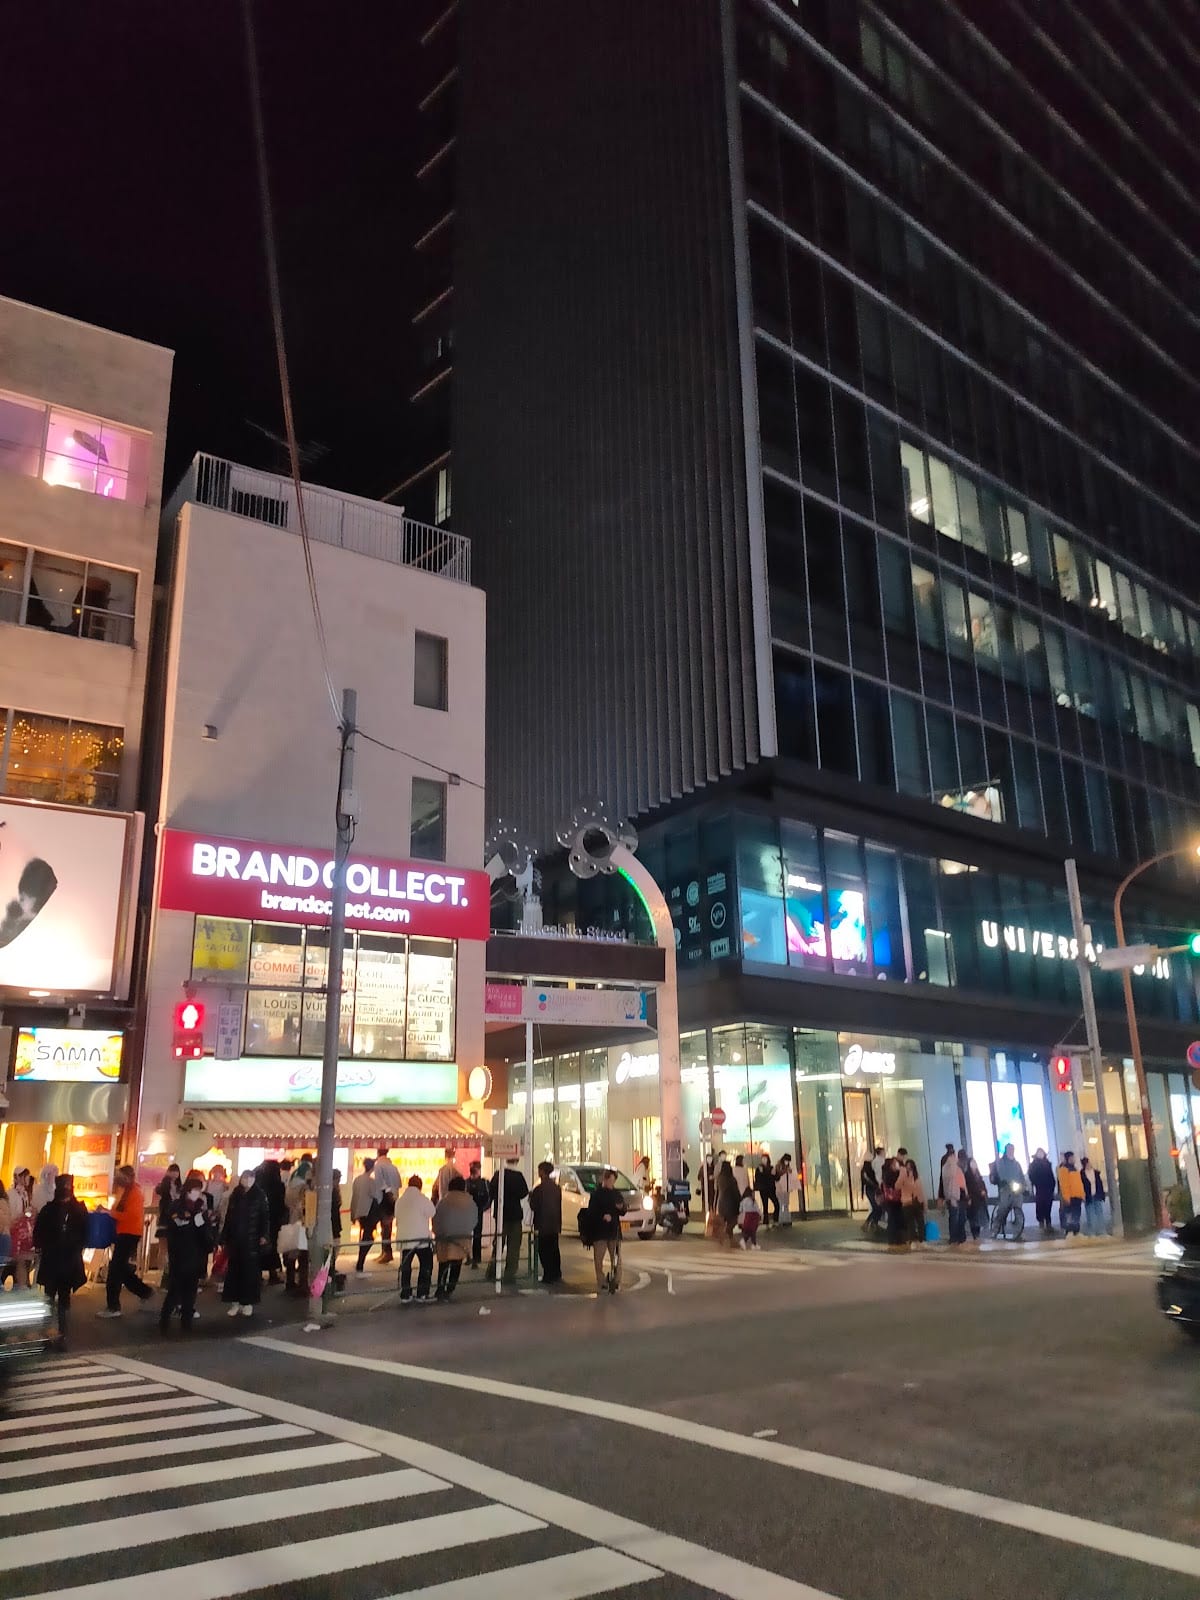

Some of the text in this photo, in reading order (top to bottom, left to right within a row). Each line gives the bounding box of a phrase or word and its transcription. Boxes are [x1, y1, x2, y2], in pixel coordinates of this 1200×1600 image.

[192, 843, 320, 889] BRAND
[253, 961, 299, 974] COMME
[307, 964, 327, 976] des
[263, 999, 298, 1010] LOUIS
[417, 993, 450, 1006] GUCCI
